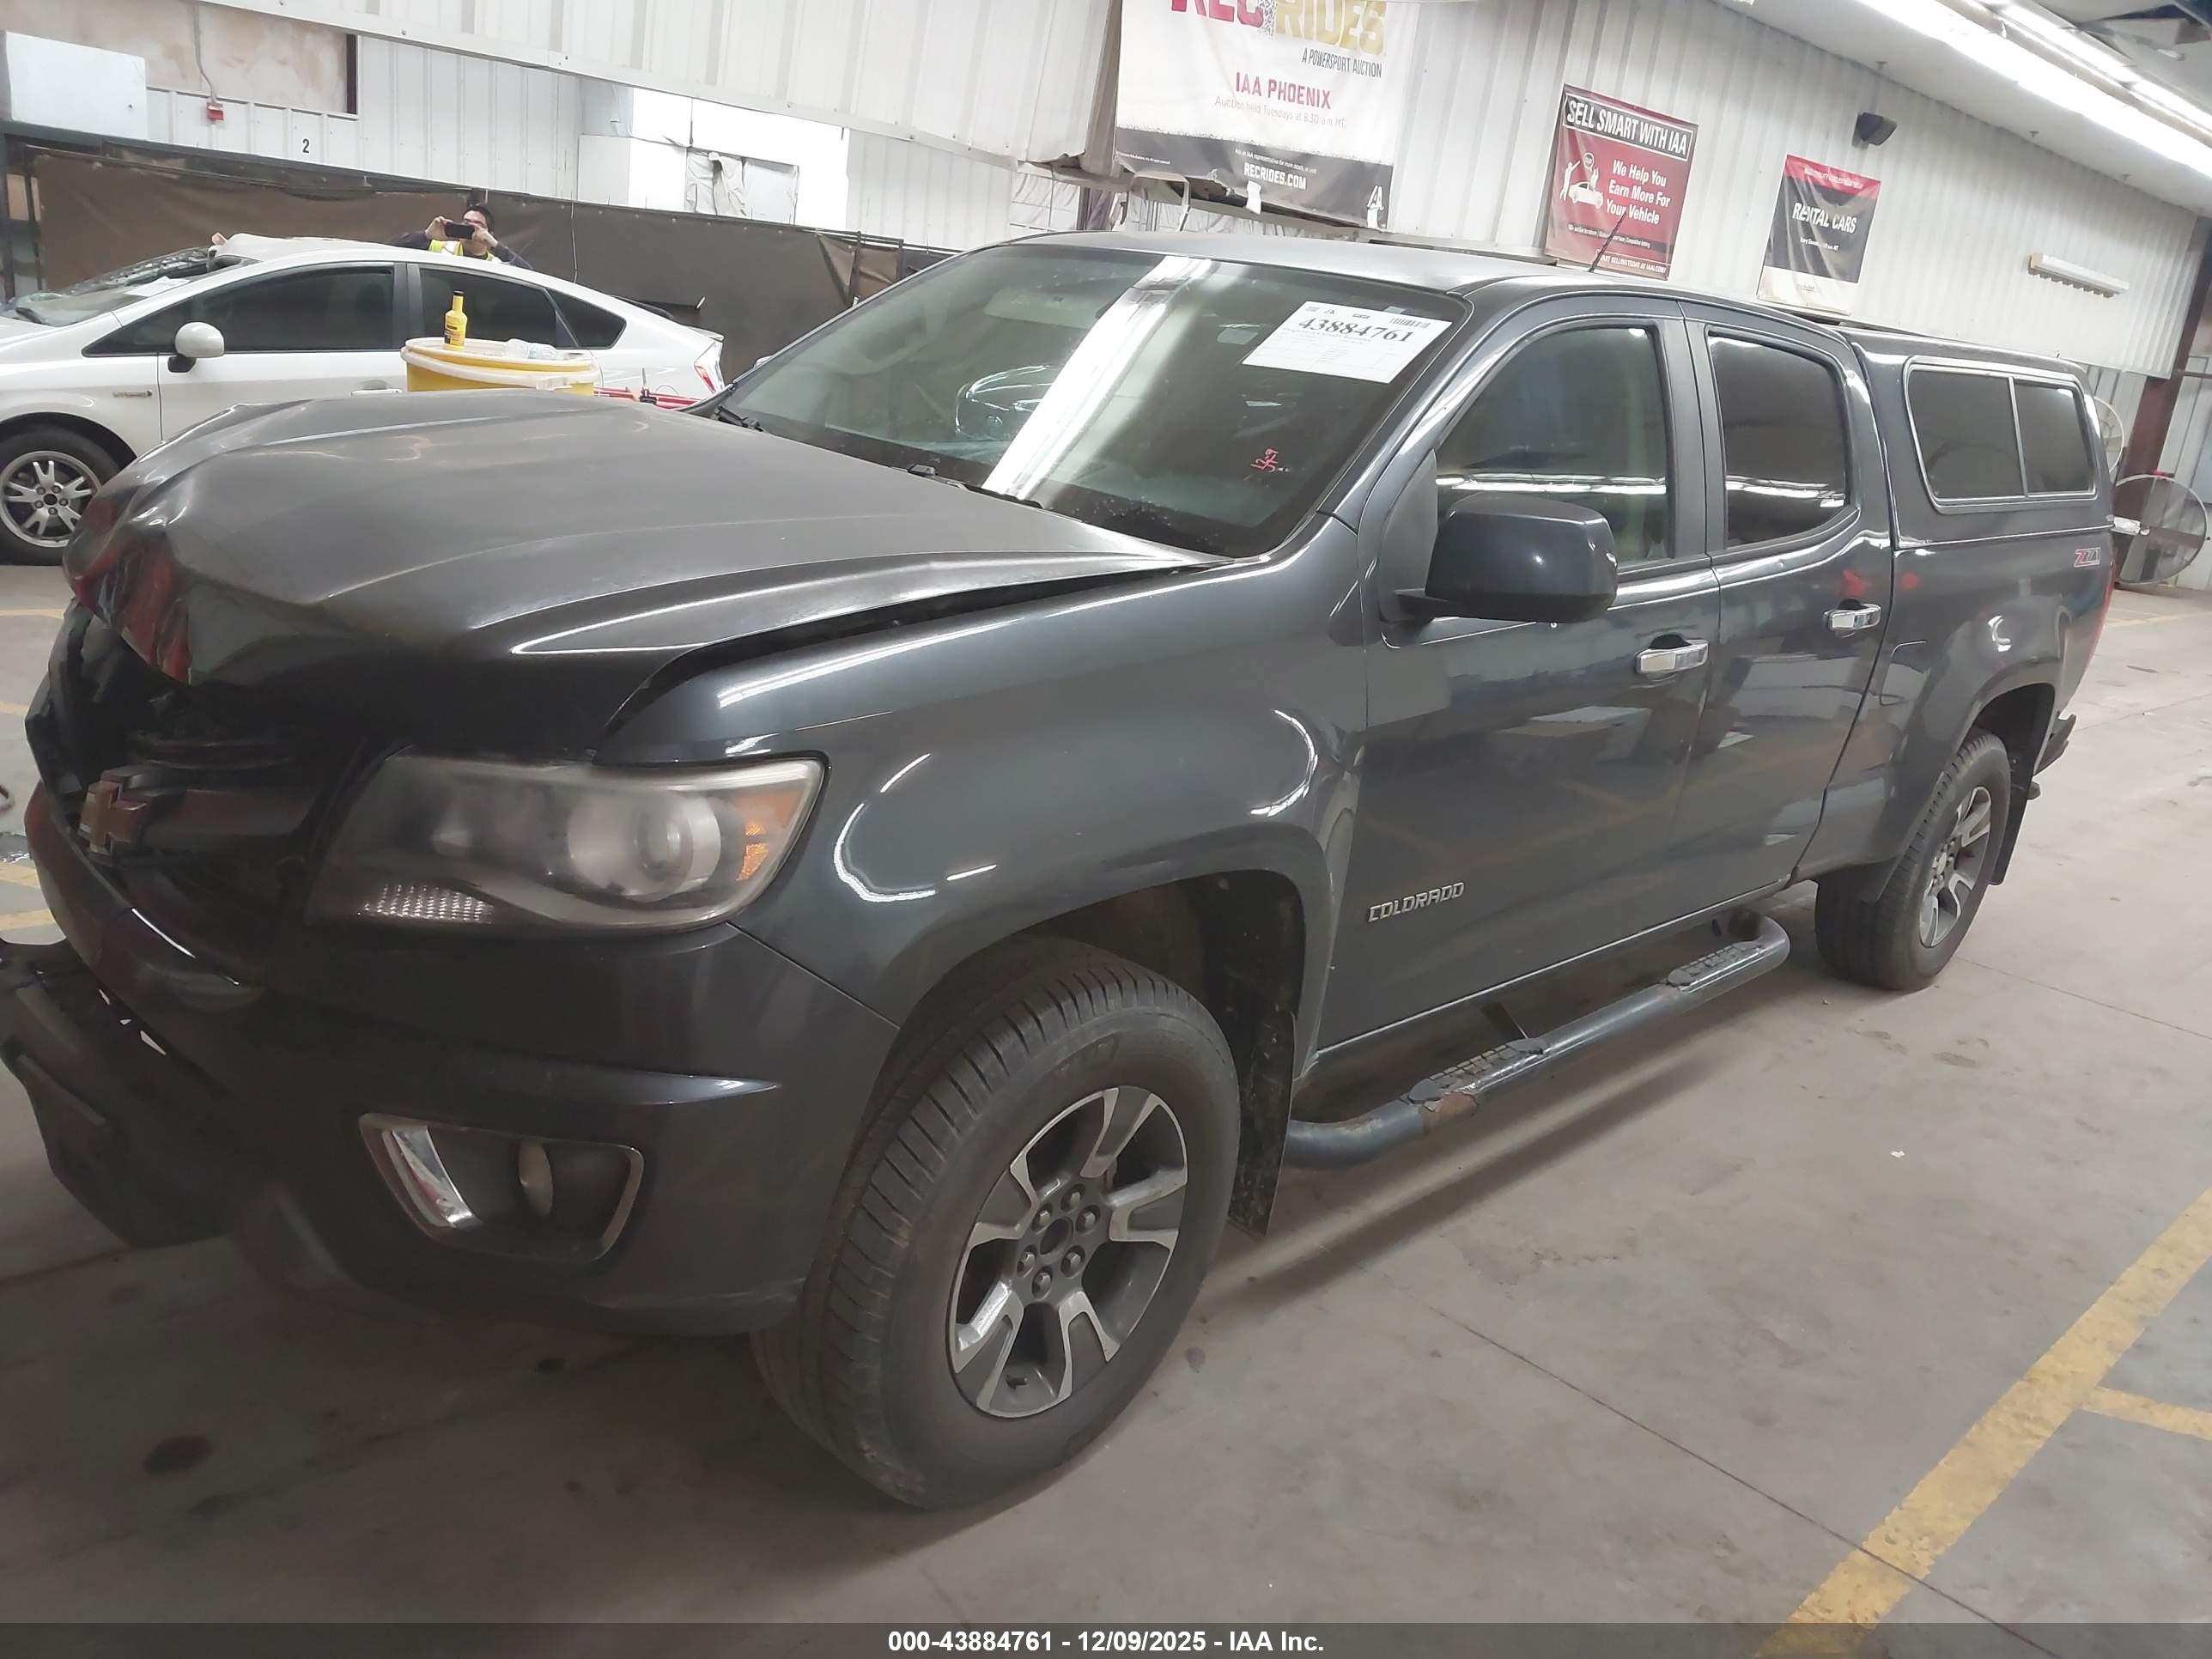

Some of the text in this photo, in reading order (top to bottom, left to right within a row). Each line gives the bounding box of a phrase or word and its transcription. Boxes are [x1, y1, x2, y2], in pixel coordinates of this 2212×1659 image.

[1302, 47, 1382, 78] A POWERSPORT AUCTION
[1236, 71, 1332, 109] IAA PHOENIX
[1263, 104, 1293, 121] Tuesdays
[1566, 100, 1687, 155] SELL SMART WITH IAA
[302, 137, 310, 154] 2
[1243, 161, 1306, 190] RECRIDES.COM
[1613, 159, 1667, 187] We Help You
[1608, 179, 1671, 207] Earn More For
[1607, 198, 1660, 225] Your Vehicle
[1792, 202, 1857, 234] RENTAL CARS
[1297, 316, 1415, 342] 43884761
[1368, 882, 1465, 922] COLORADO
